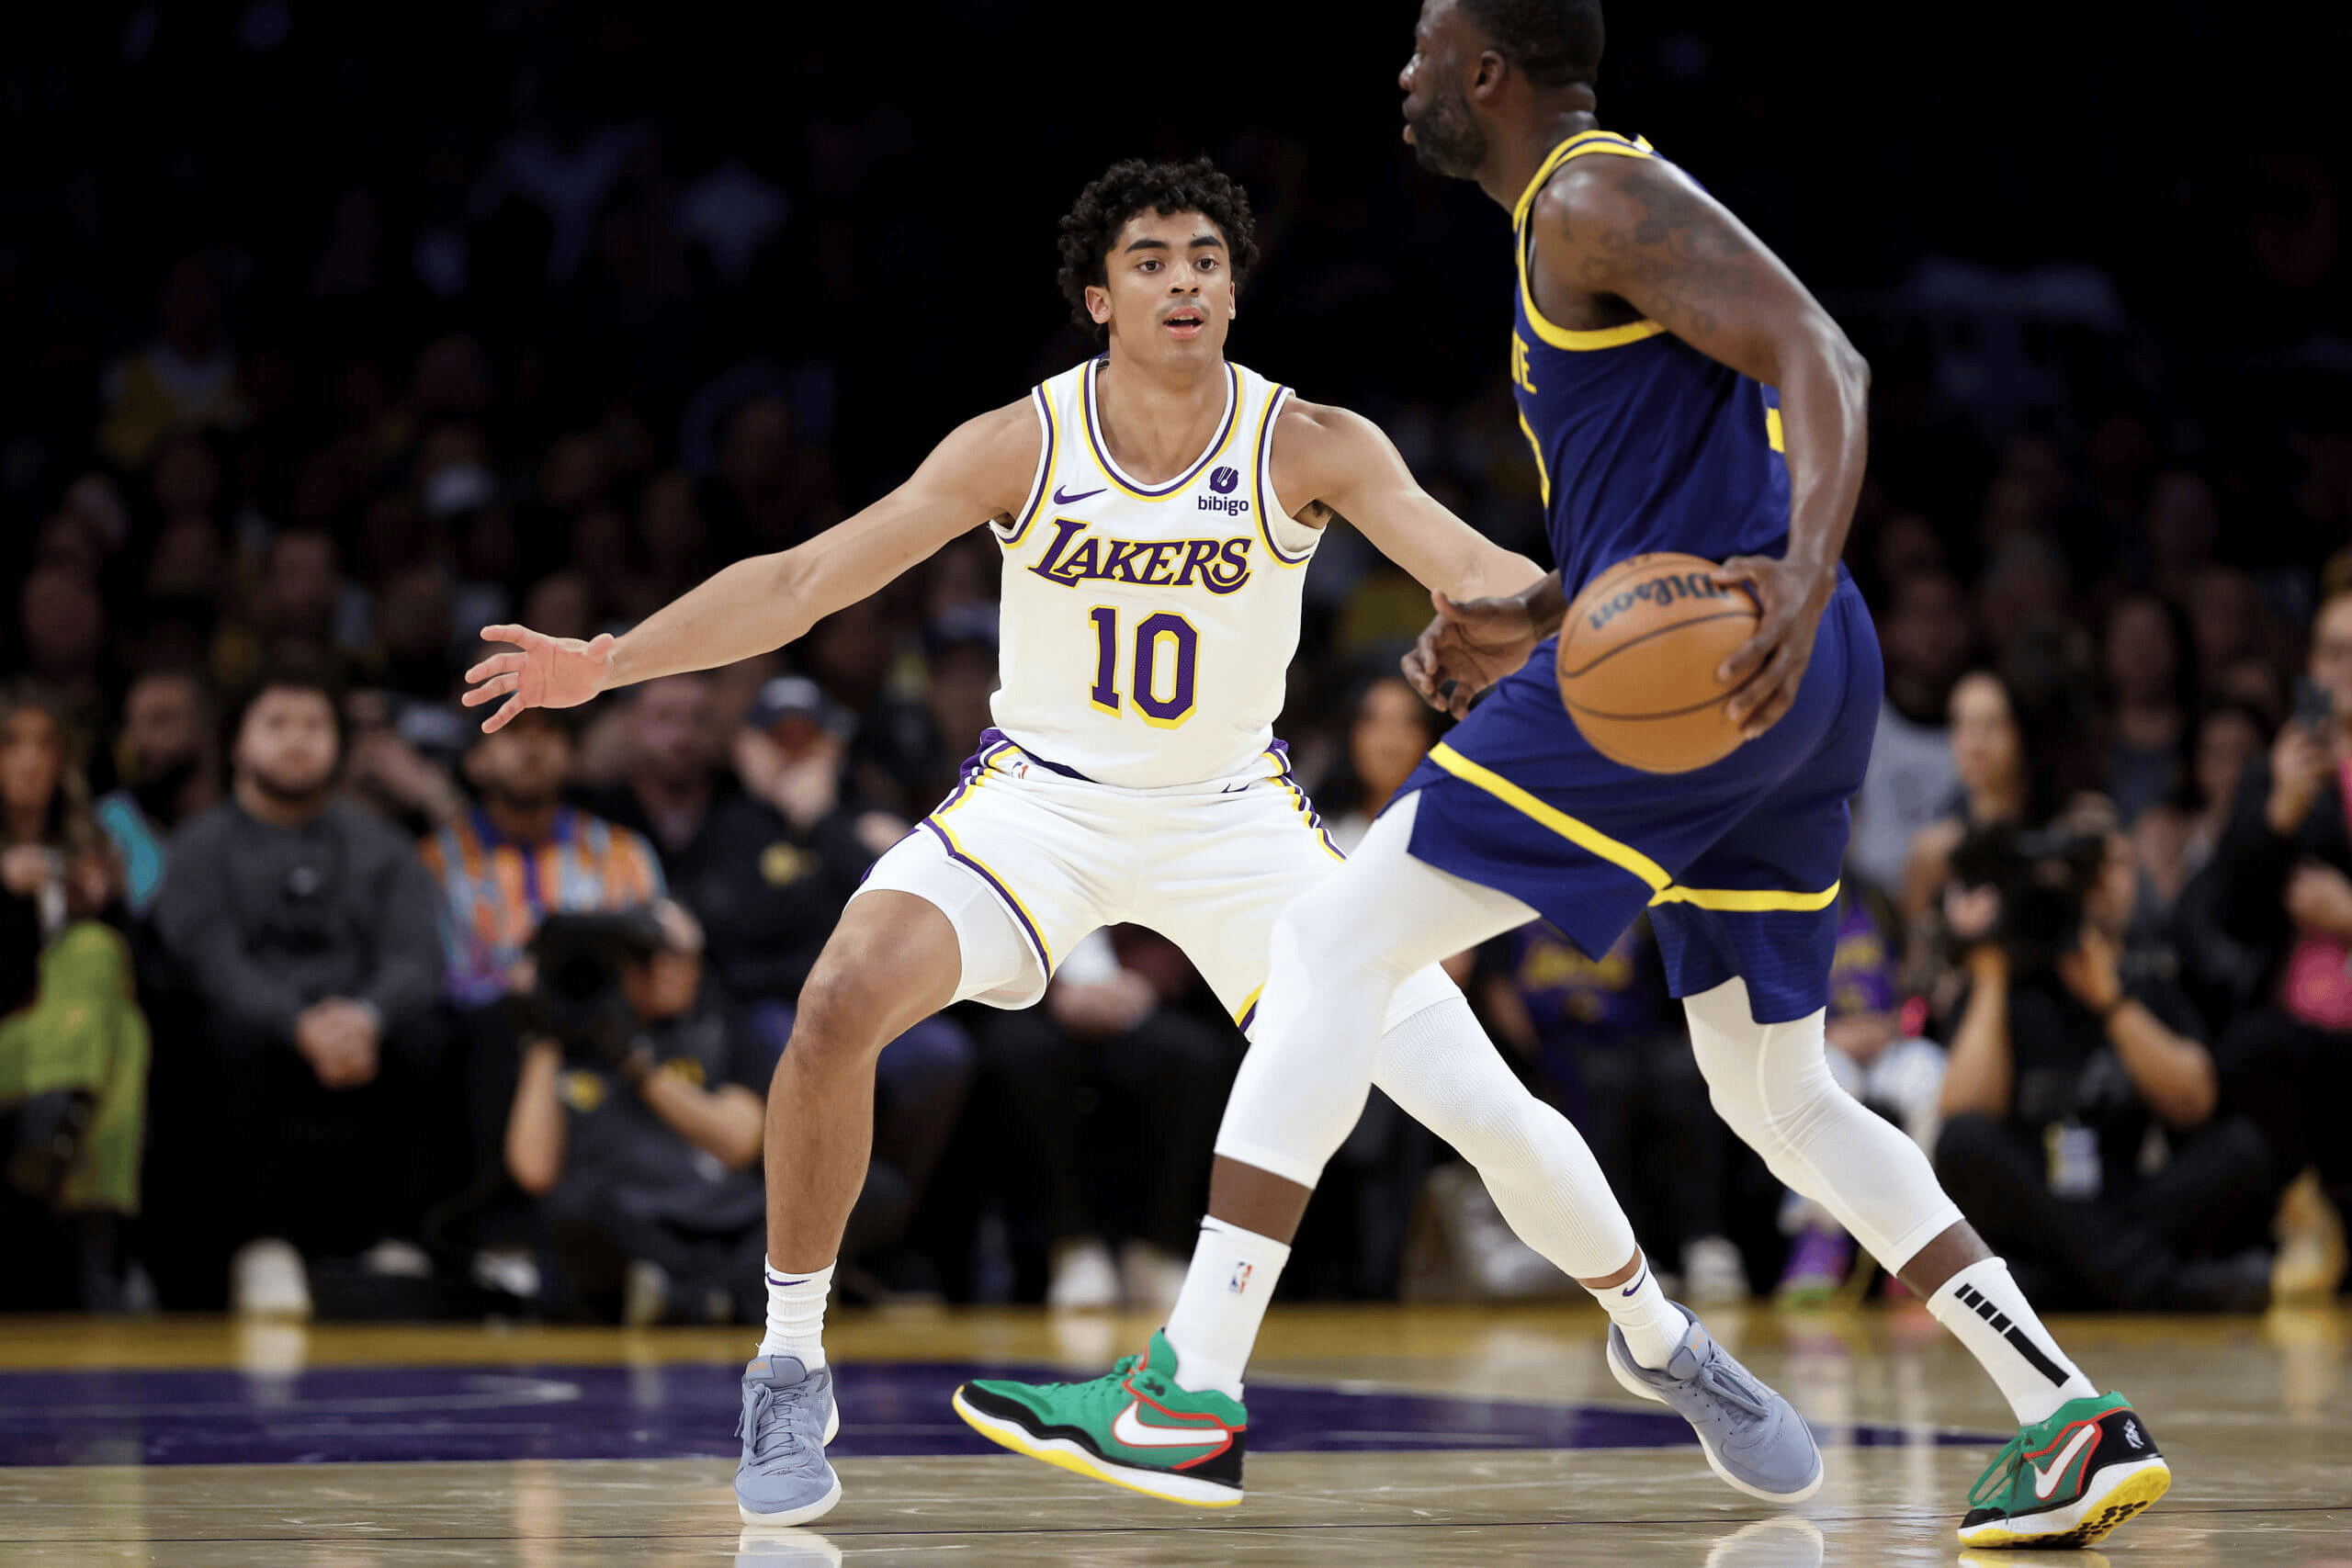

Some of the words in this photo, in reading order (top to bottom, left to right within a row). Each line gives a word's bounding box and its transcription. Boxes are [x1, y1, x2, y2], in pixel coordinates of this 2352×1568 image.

[1198, 495, 1250, 516] bibigo
[1026, 516, 1255, 597] LAKERS
[1088, 604, 1201, 730] 10
